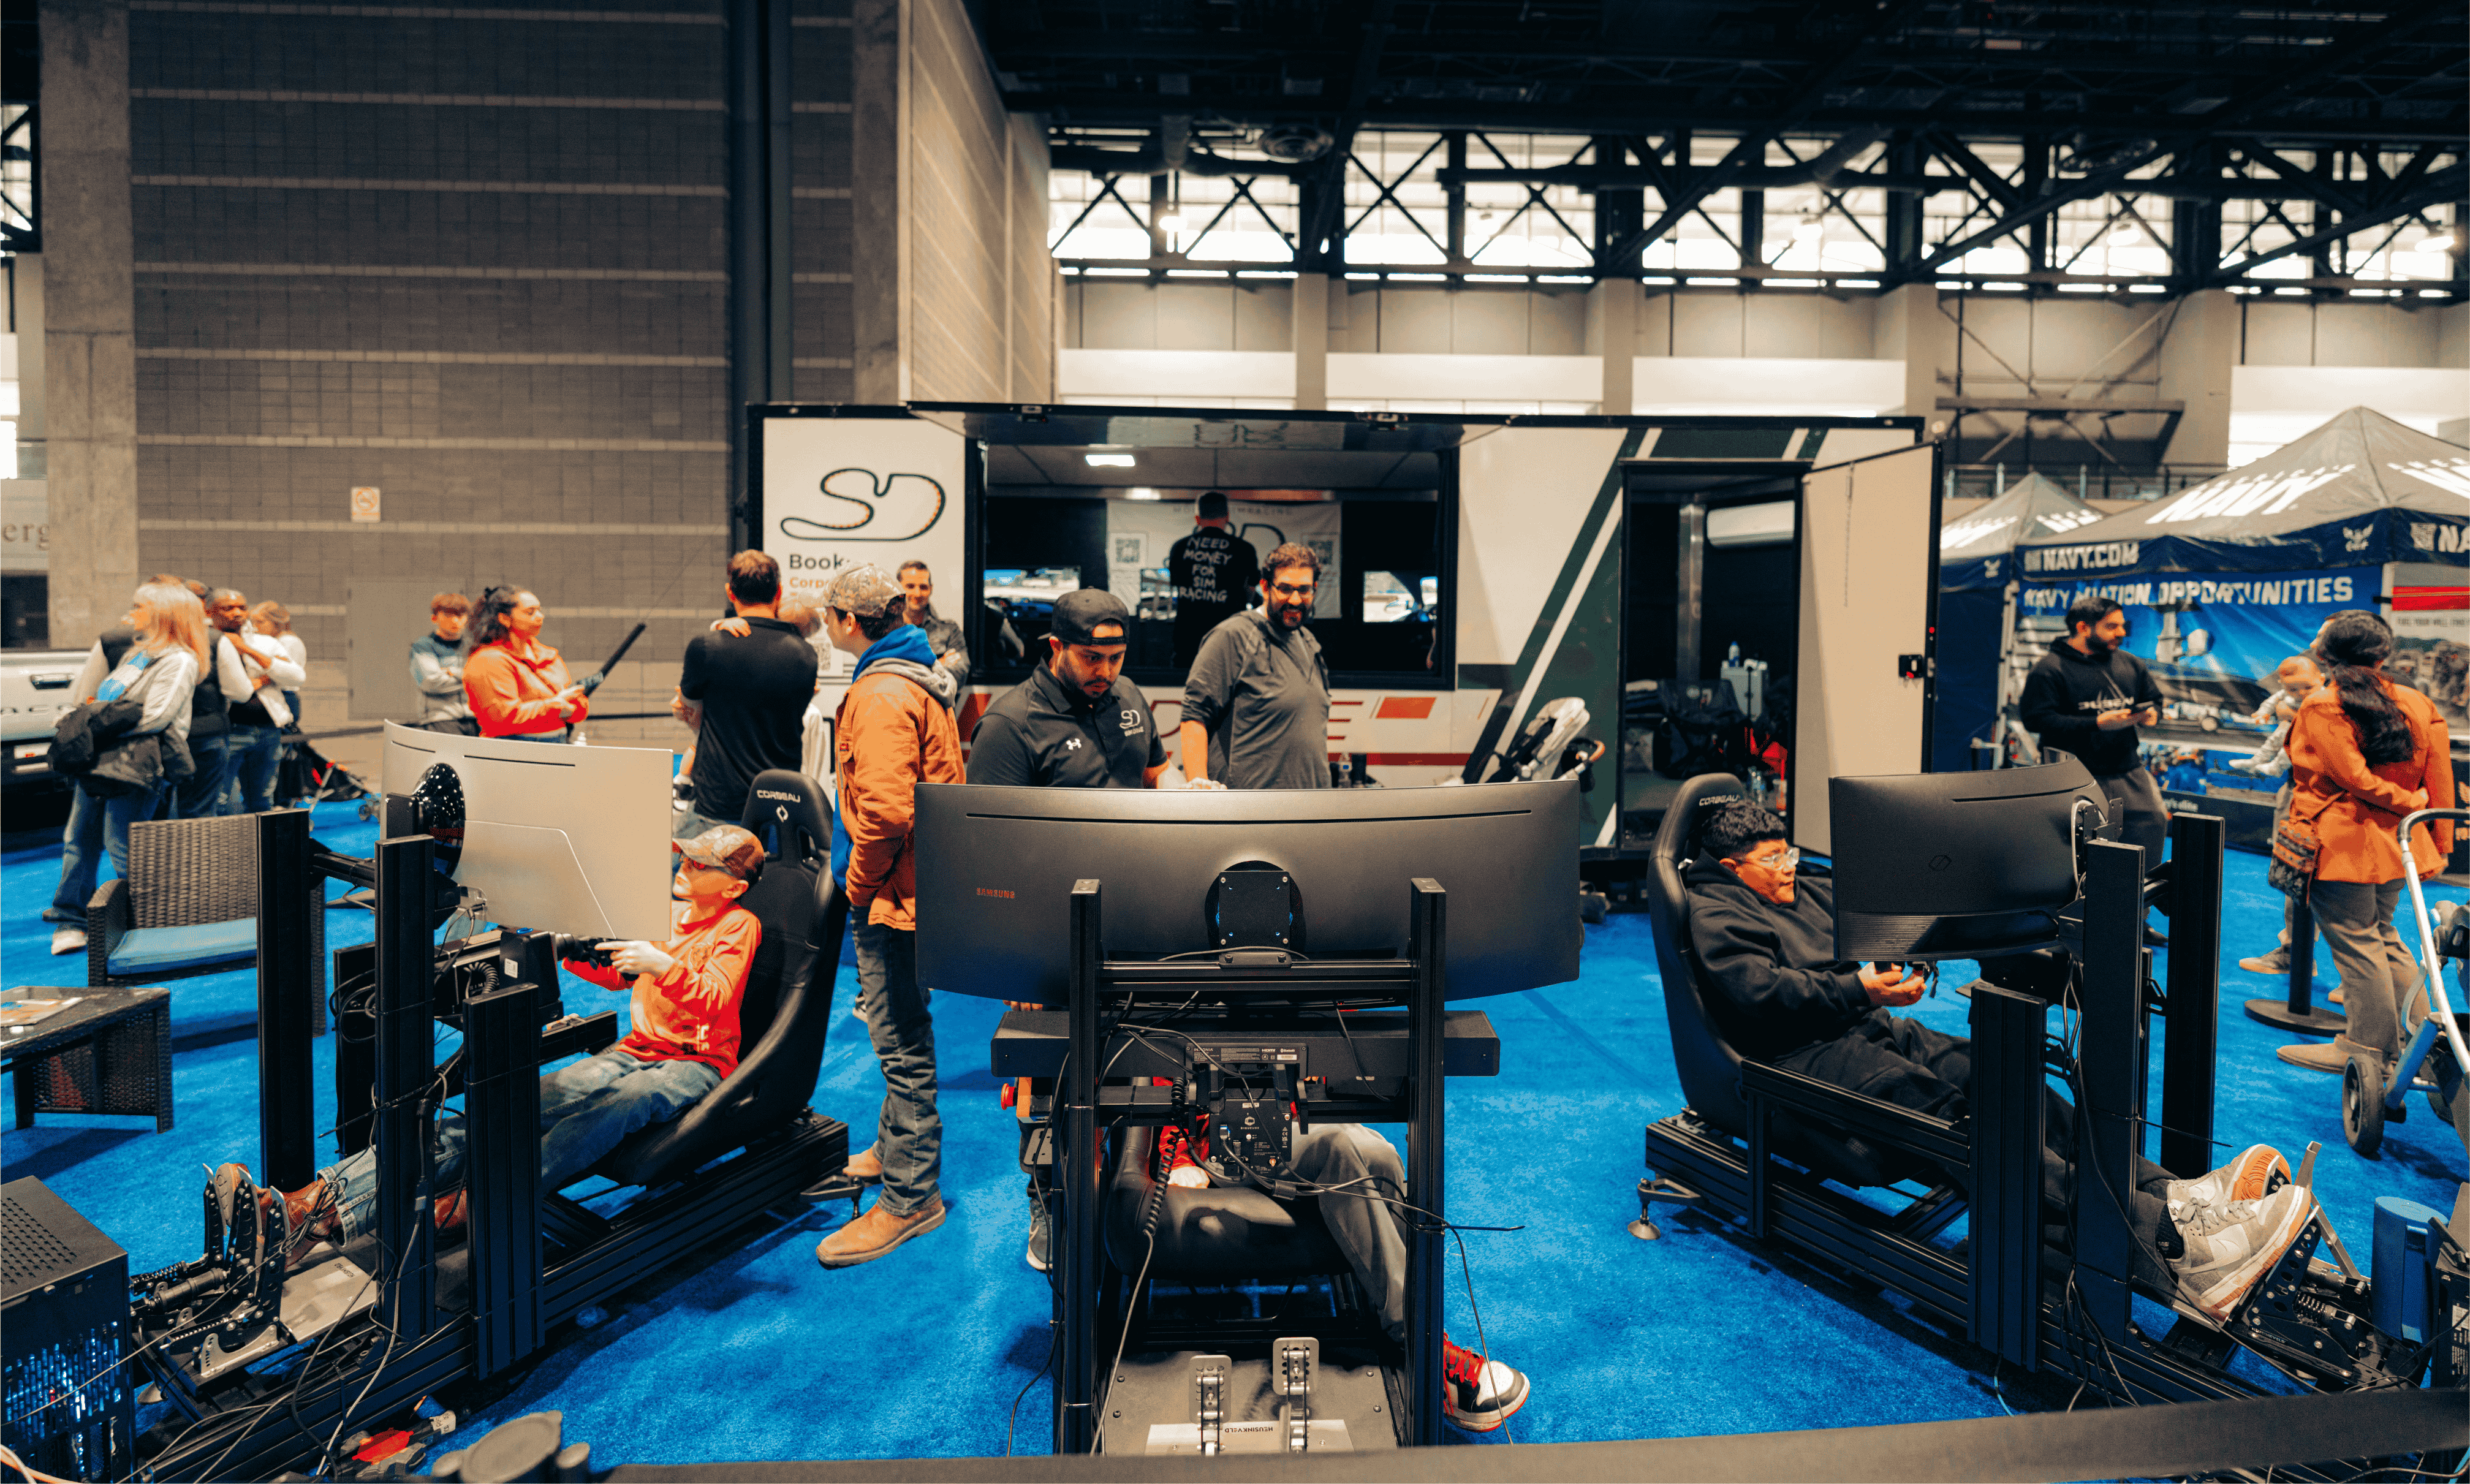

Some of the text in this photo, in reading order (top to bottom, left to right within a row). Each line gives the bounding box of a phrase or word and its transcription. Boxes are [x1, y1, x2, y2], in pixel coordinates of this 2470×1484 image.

[1187, 537, 1230, 550] NEED
[1183, 550, 1232, 566] MONEY
[2043, 542, 2139, 572] NAVY.COM
[1192, 564, 1216, 577] FOR
[789, 577, 829, 589] Corp
[1194, 576, 1216, 589] SIM
[1178, 586, 1228, 603] RACING
[2024, 588, 2070, 609] NAVY
[757, 789, 801, 803] CORBEAU
[1699, 794, 1740, 806] CORBEAU
[976, 887, 1015, 899] SAMSUNG
